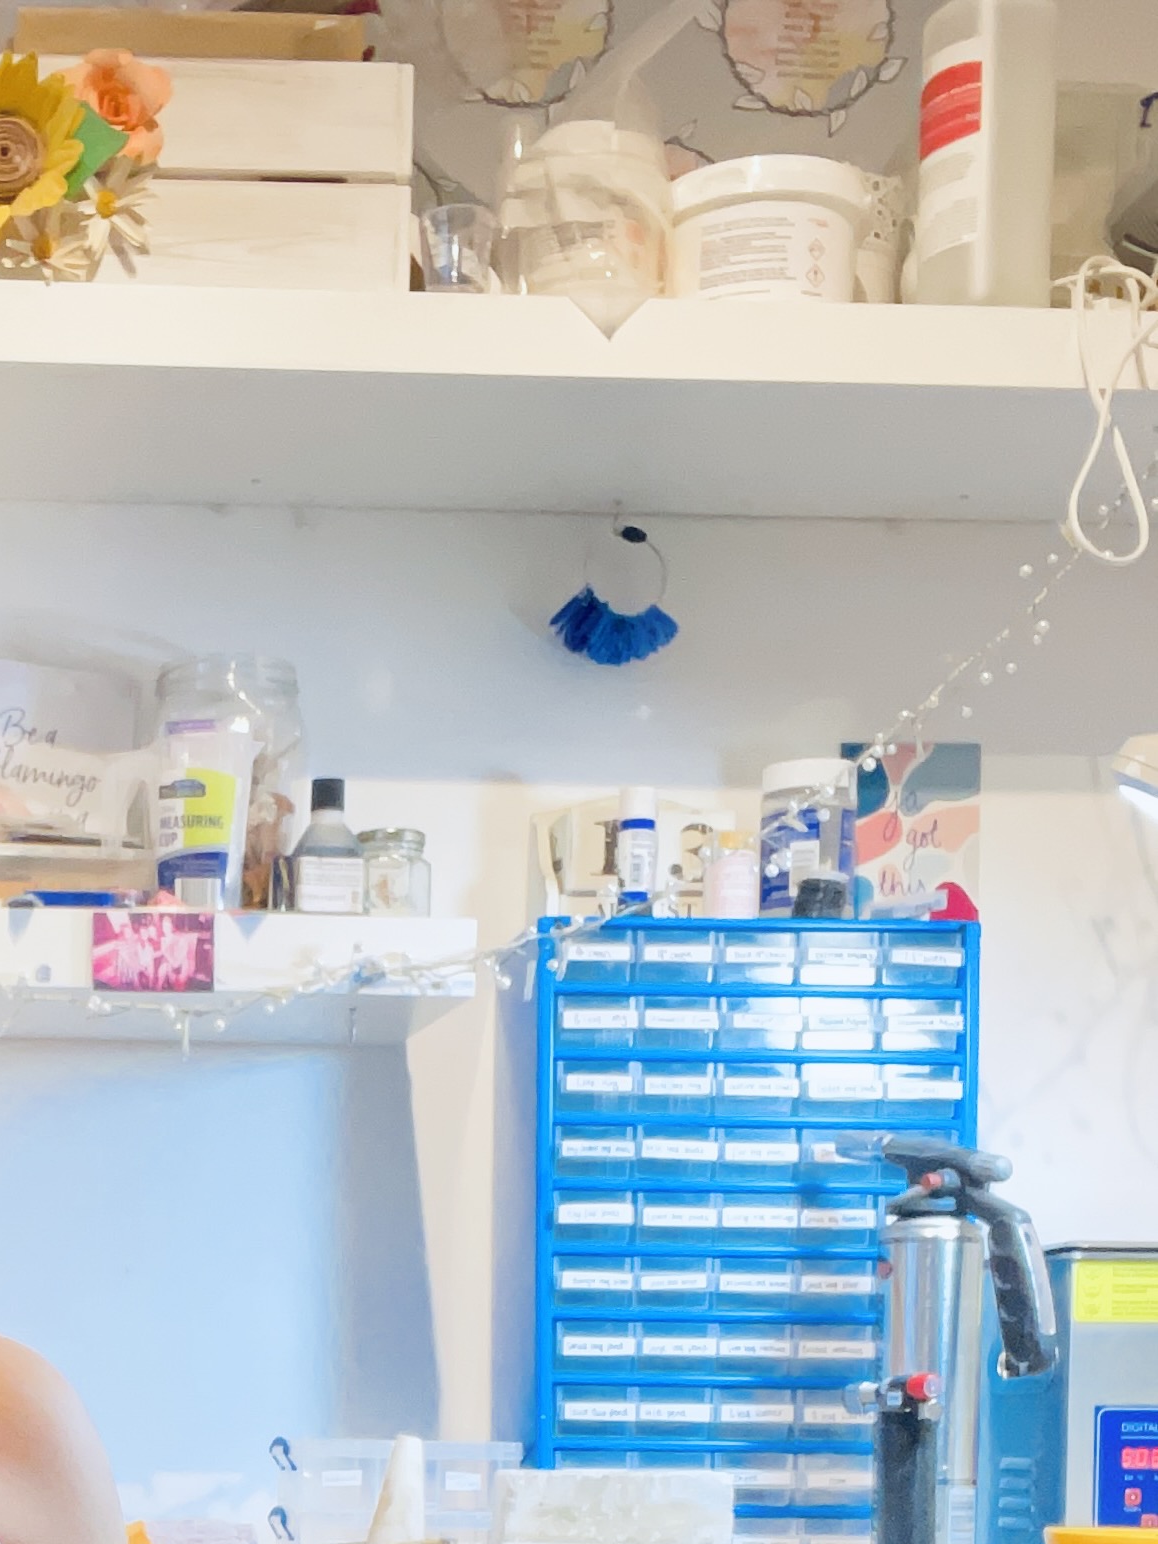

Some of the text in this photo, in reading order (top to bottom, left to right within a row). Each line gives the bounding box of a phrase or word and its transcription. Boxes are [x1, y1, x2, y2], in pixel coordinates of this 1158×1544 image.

[159, 814, 224, 830] MEASURING
[903, 819, 941, 870] got
[878, 870, 925, 896] this
